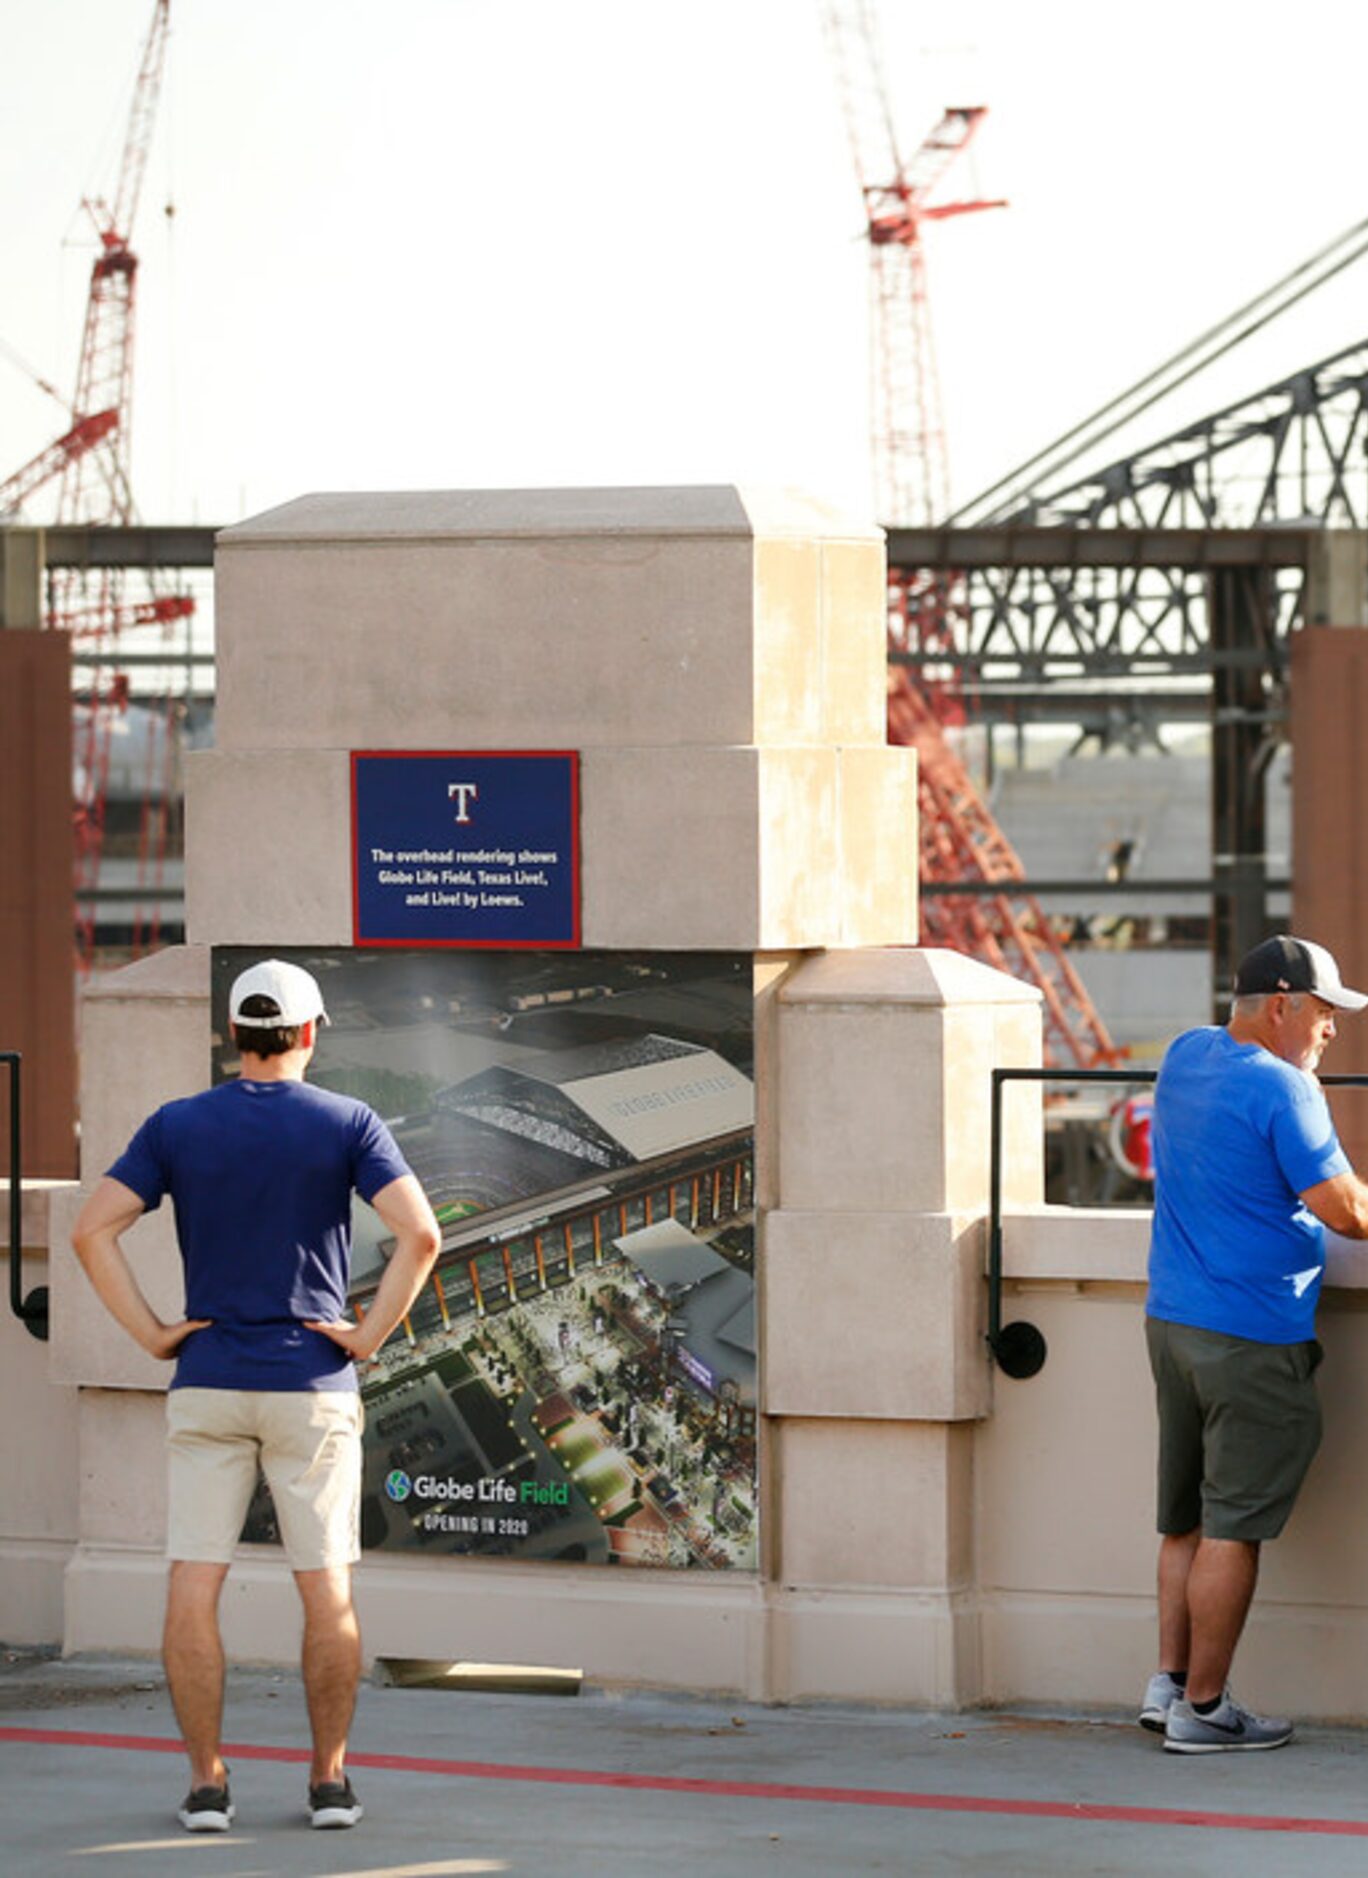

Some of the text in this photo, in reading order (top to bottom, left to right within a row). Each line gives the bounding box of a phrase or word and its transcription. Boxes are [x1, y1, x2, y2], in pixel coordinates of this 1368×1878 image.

[448, 784, 478, 824] T
[371, 849, 558, 866] The overhead rendering shows
[378, 870, 414, 885] Globe
[416, 870, 439, 885] Life
[441, 870, 476, 886] Field,
[478, 871, 511, 885] Texas
[405, 892, 524, 909] and Live! by Loews.
[414, 1476, 569, 1505] Globe Life Field
[424, 1514, 528, 1535] OPENING IN 2020
